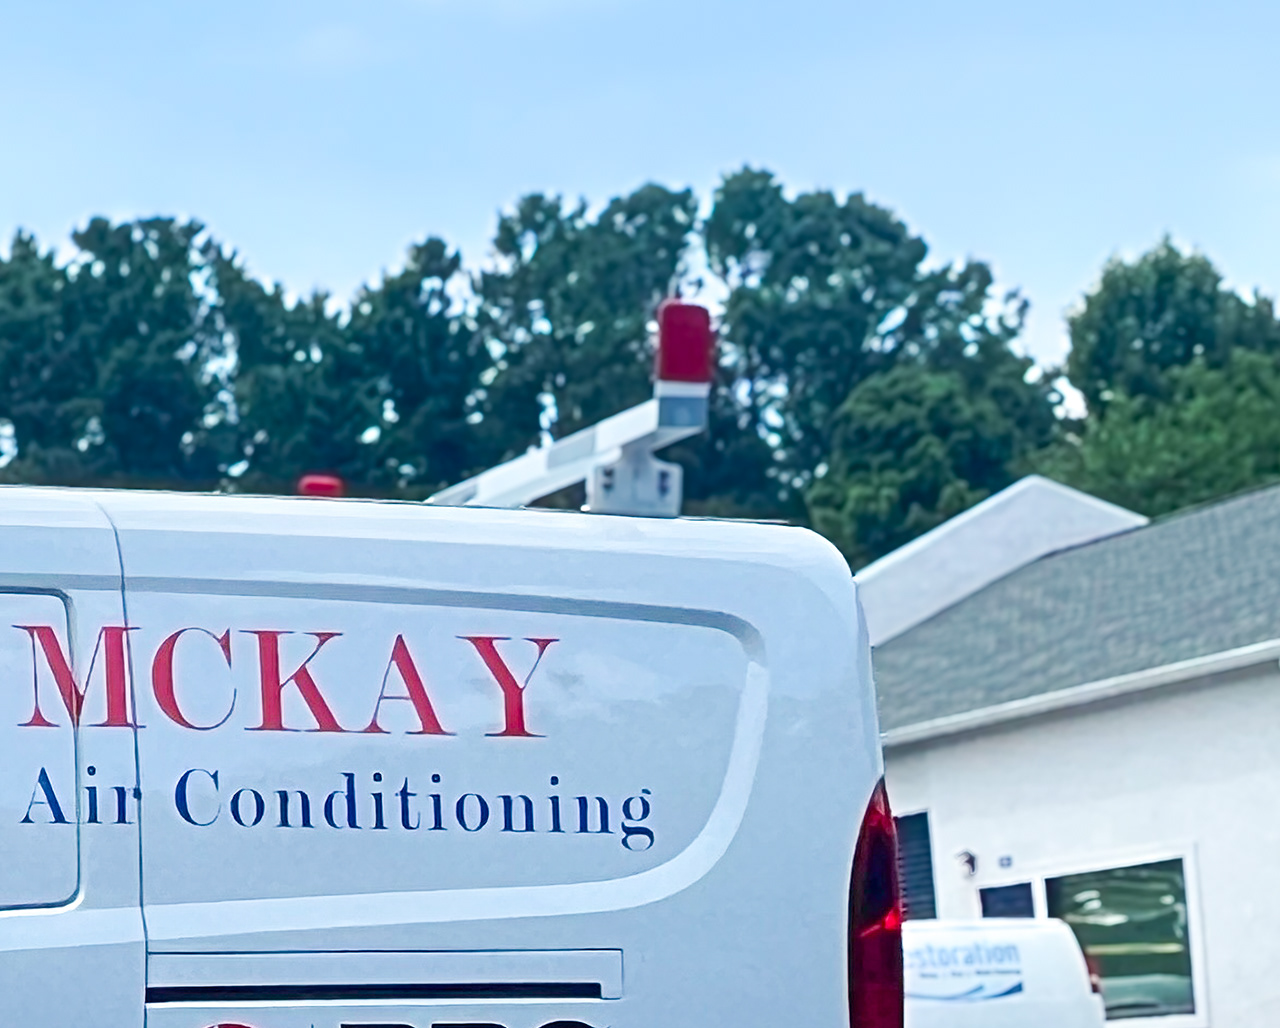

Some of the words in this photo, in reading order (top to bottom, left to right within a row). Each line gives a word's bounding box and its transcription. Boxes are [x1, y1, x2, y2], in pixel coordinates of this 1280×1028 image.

[13, 623, 561, 739] MCKAY
[18, 766, 142, 828] Air
[172, 767, 655, 852] Conditioning
